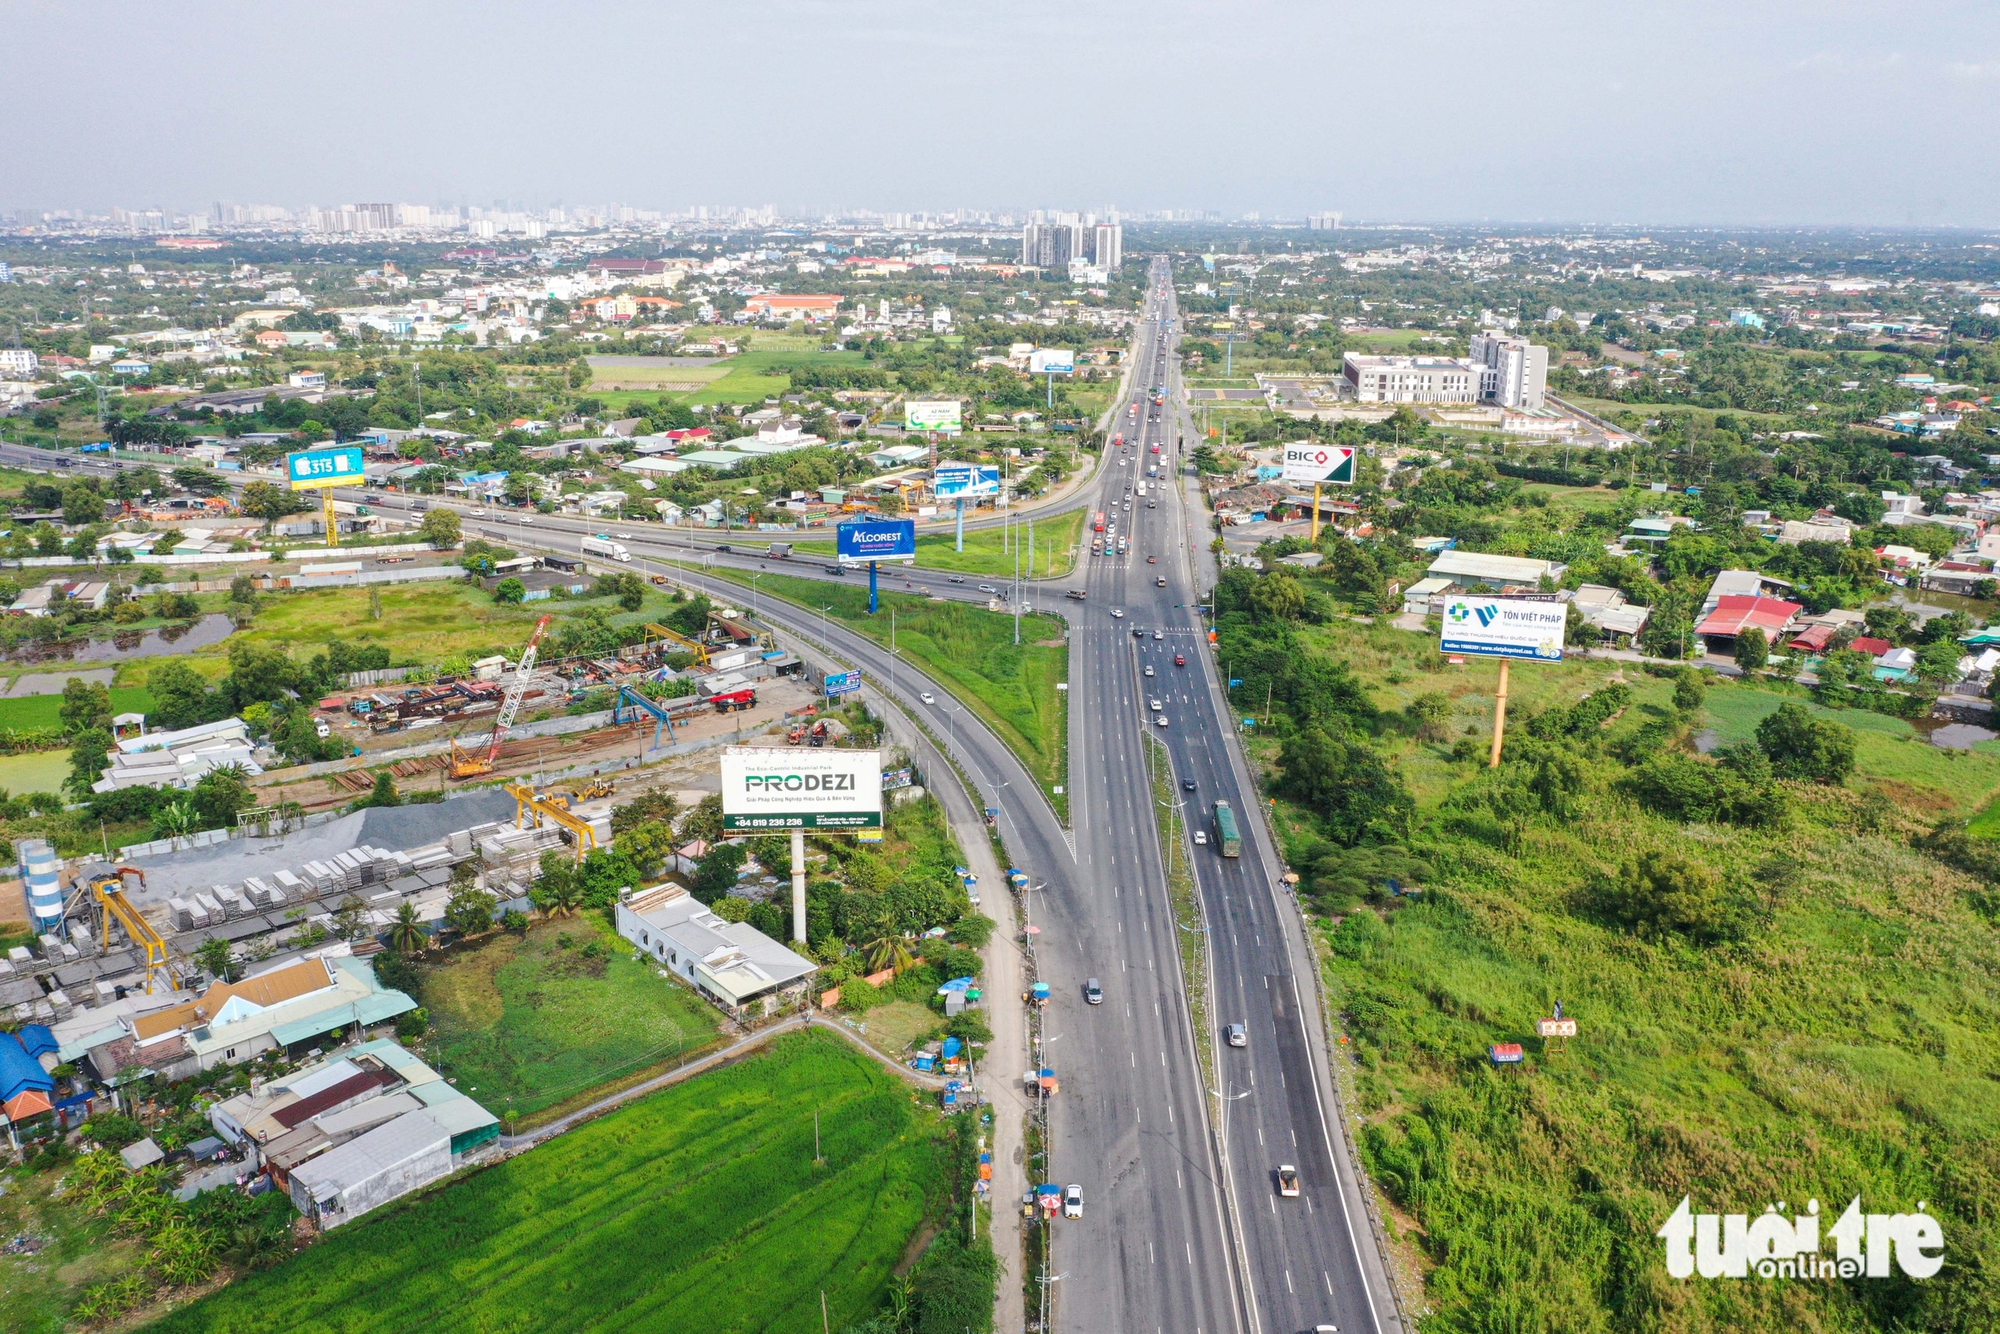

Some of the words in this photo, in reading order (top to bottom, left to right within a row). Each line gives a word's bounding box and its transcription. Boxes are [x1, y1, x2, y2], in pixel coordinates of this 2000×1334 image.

[312, 462, 333, 474] 315
[852, 530, 902, 543] ALCOREST
[1503, 609, 1519, 620] TÔN
[1520, 611, 1538, 623] VIỆT
[1539, 613, 1562, 623] PHÁP
[745, 774, 855, 792] PRODEZI
[735, 819, 751, 827] +84
[752, 819, 767, 827] 819
